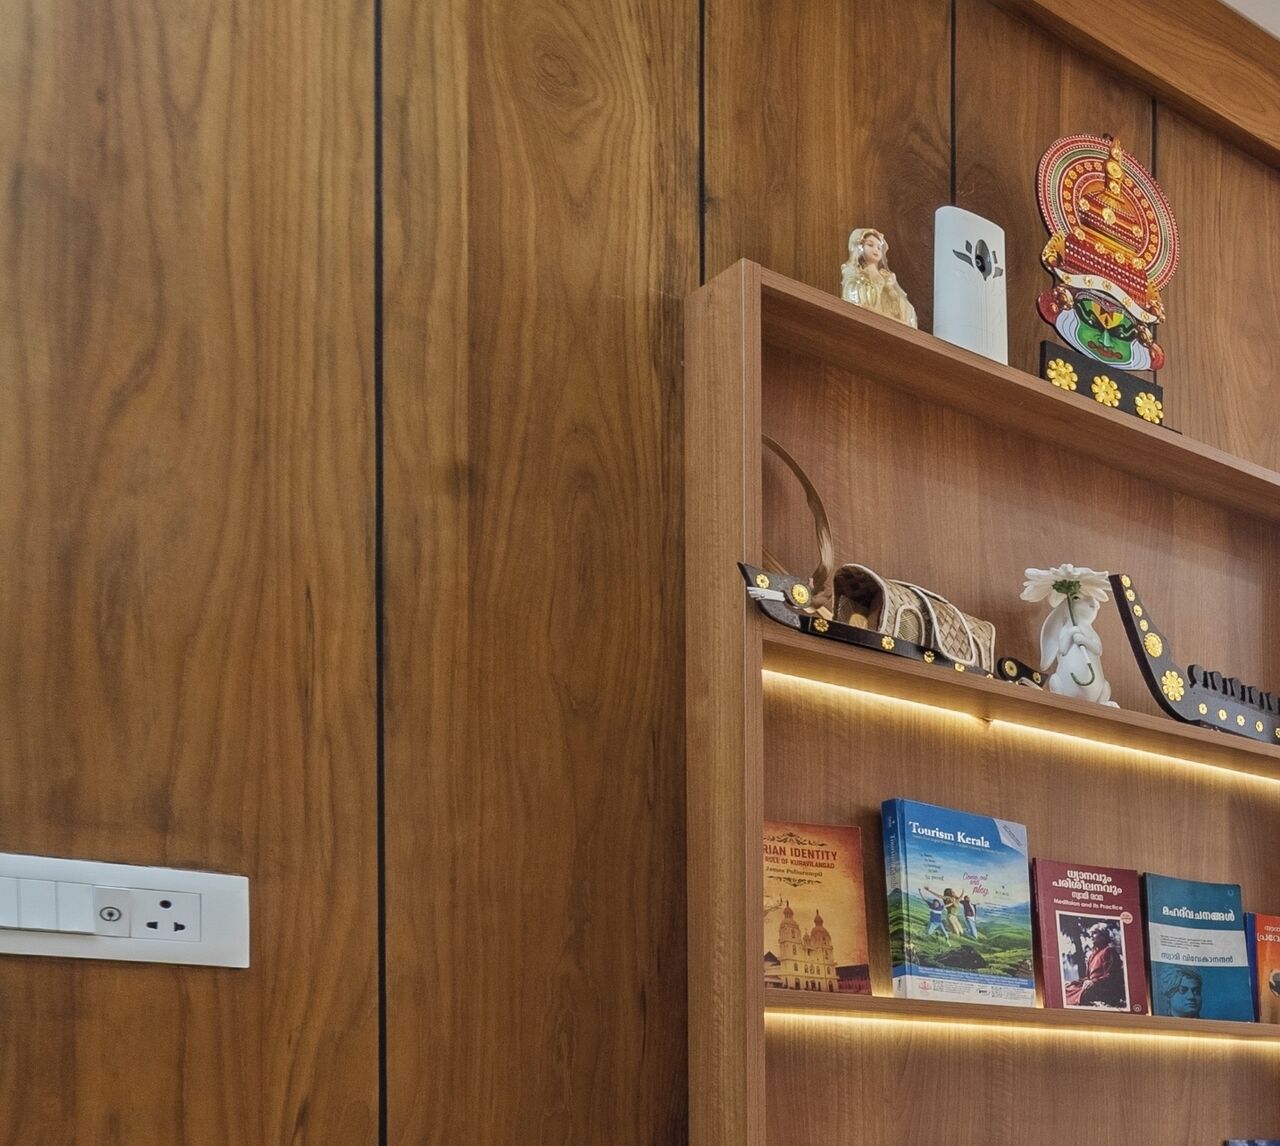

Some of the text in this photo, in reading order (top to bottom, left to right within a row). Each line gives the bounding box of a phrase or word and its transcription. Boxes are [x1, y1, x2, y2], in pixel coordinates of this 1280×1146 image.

[909, 821, 955, 841] Tourism
[957, 831, 990, 848] Kerala
[790, 847, 838, 861] IDENTITY
[1052, 879, 1122, 896] പരിശീലനവും
